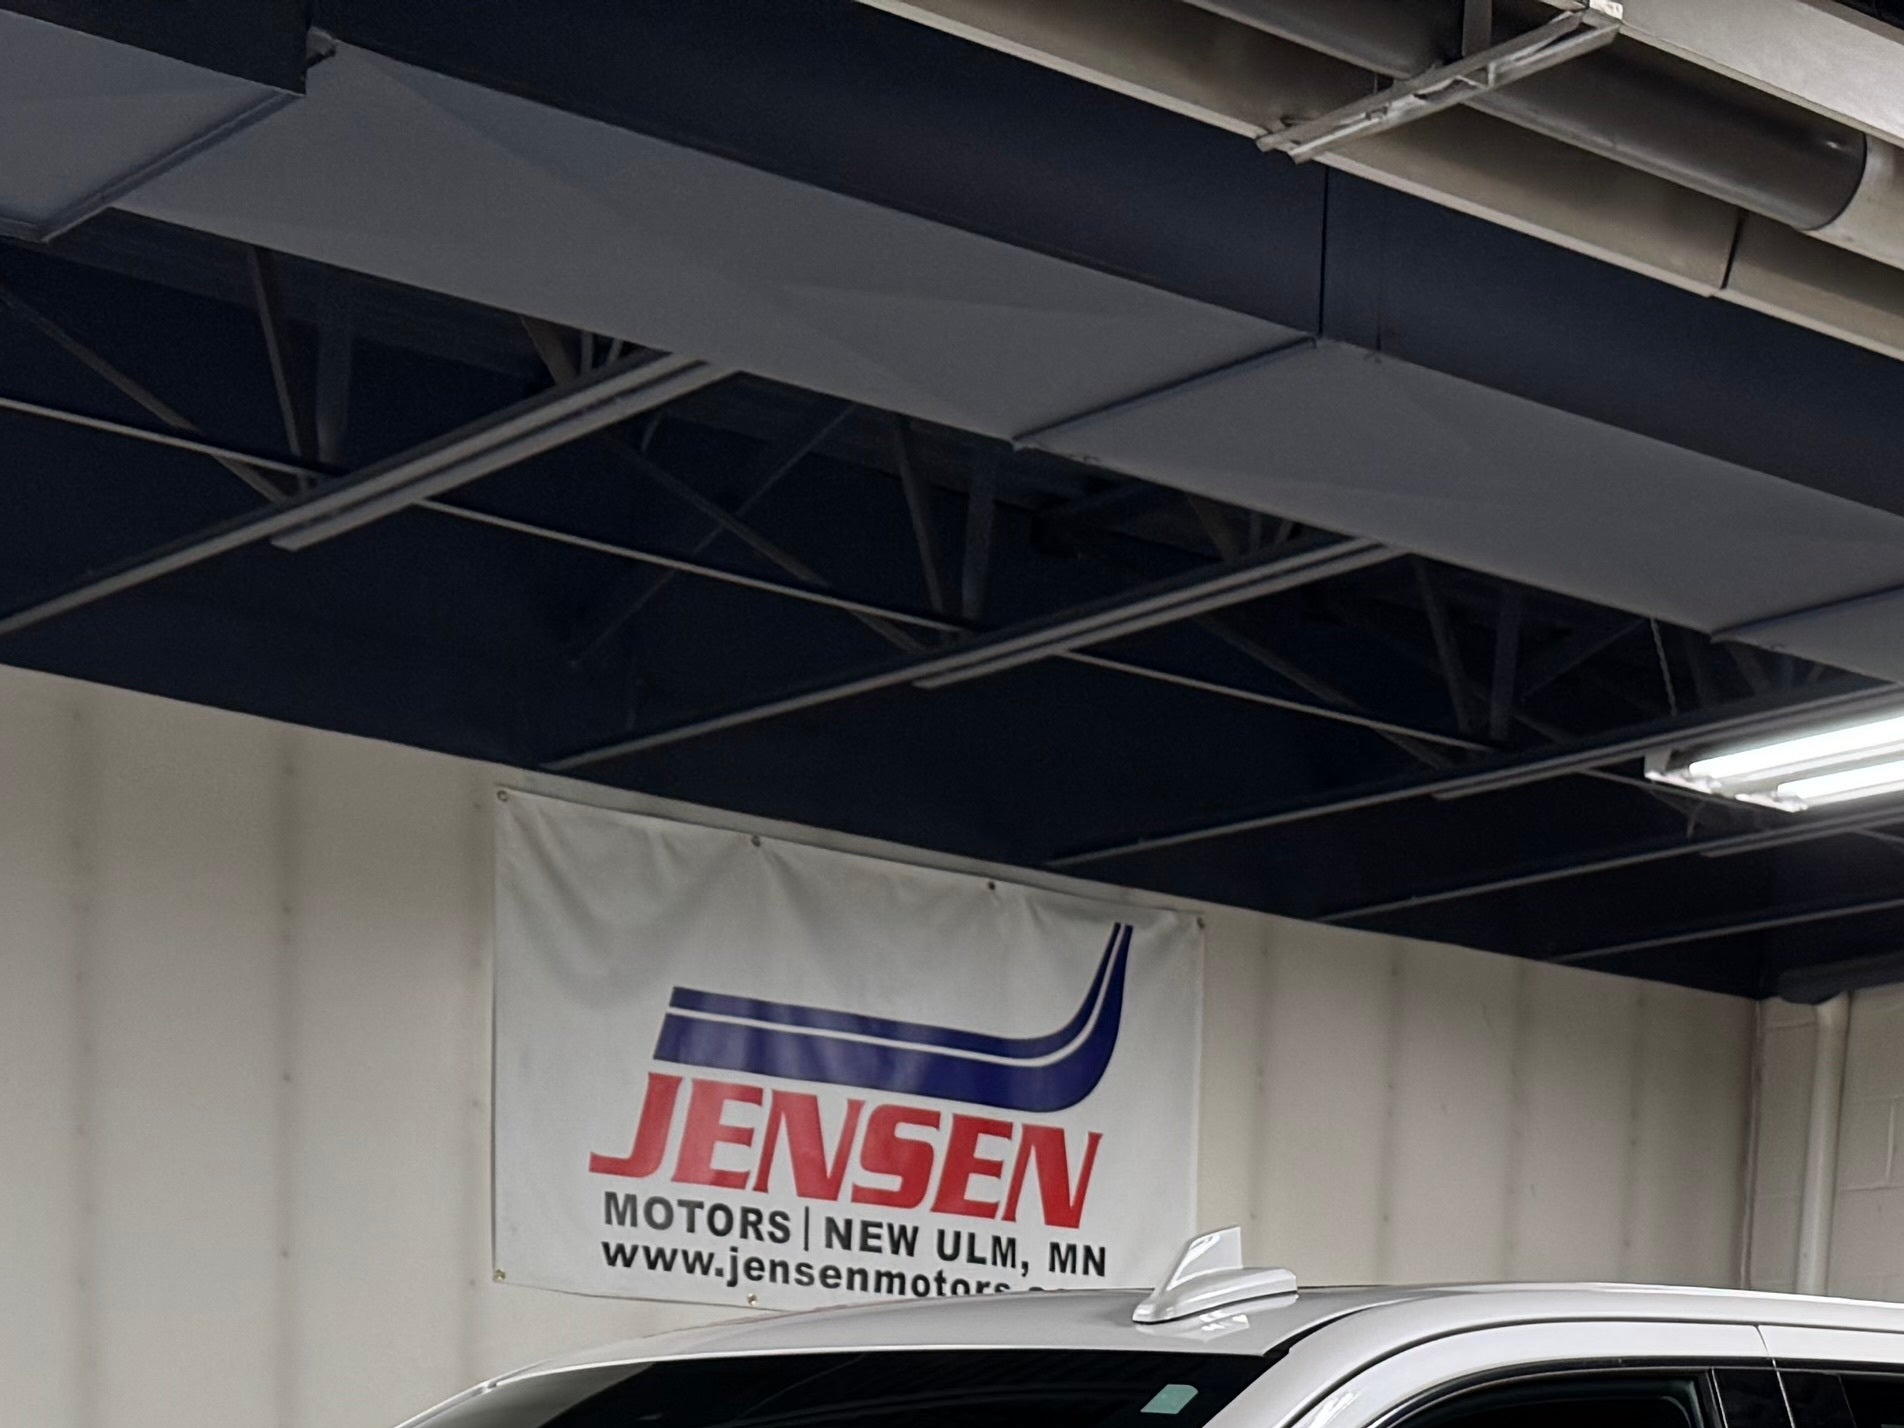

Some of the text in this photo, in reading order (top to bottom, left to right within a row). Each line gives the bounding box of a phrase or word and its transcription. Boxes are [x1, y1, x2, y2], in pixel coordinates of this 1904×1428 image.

[589, 1072, 1103, 1229] JENSEN
[604, 1191, 1105, 1277] MOTORS NEW ULM, MN
